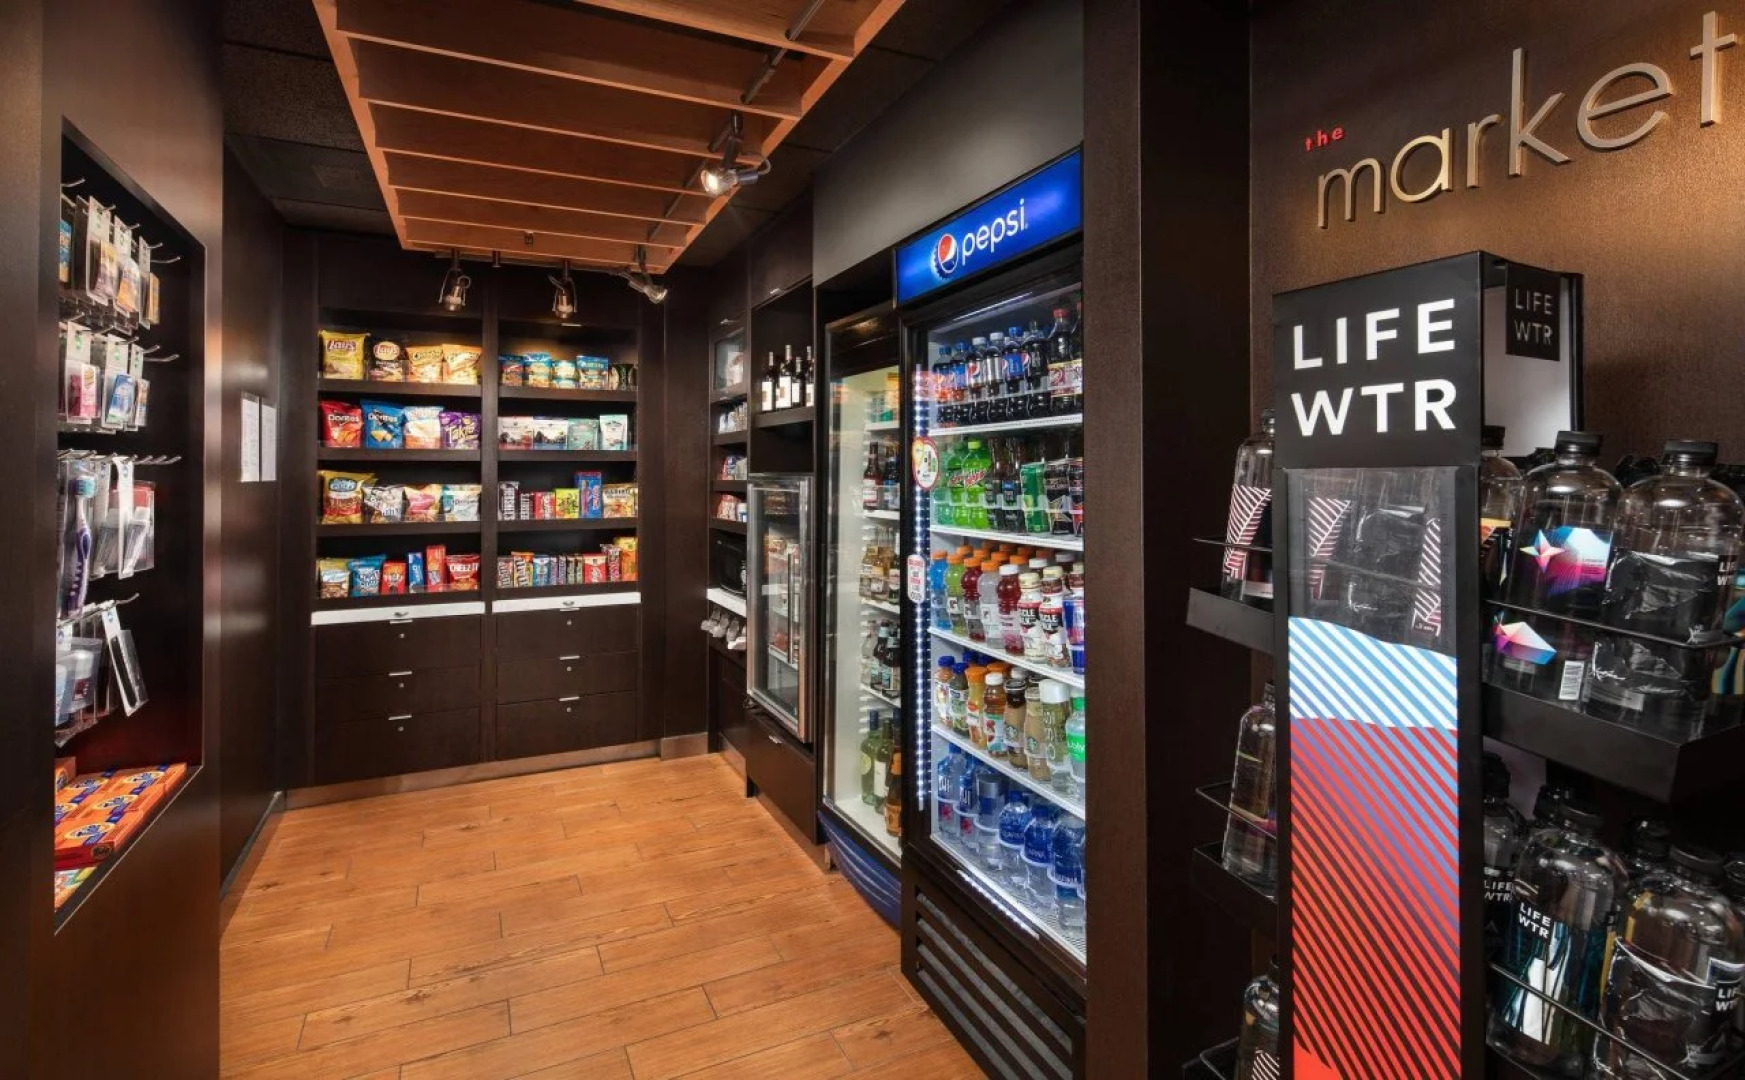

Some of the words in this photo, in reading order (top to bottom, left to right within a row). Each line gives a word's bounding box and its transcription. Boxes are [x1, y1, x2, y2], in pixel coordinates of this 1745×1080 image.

[1317, 10, 1738, 229] market
[1304, 124, 1346, 152] the
[961, 197, 1025, 267] pepsi
[1514, 288, 1554, 316] LIFE
[1293, 298, 1456, 370] LIFE
[1514, 320, 1554, 346] WTR
[1290, 378, 1458, 438] WTR
[1484, 880, 1513, 891] LIFE
[1518, 913, 1550, 938] WTR
[1519, 901, 1551, 927] LIFE
[1718, 986, 1741, 999] LIF
